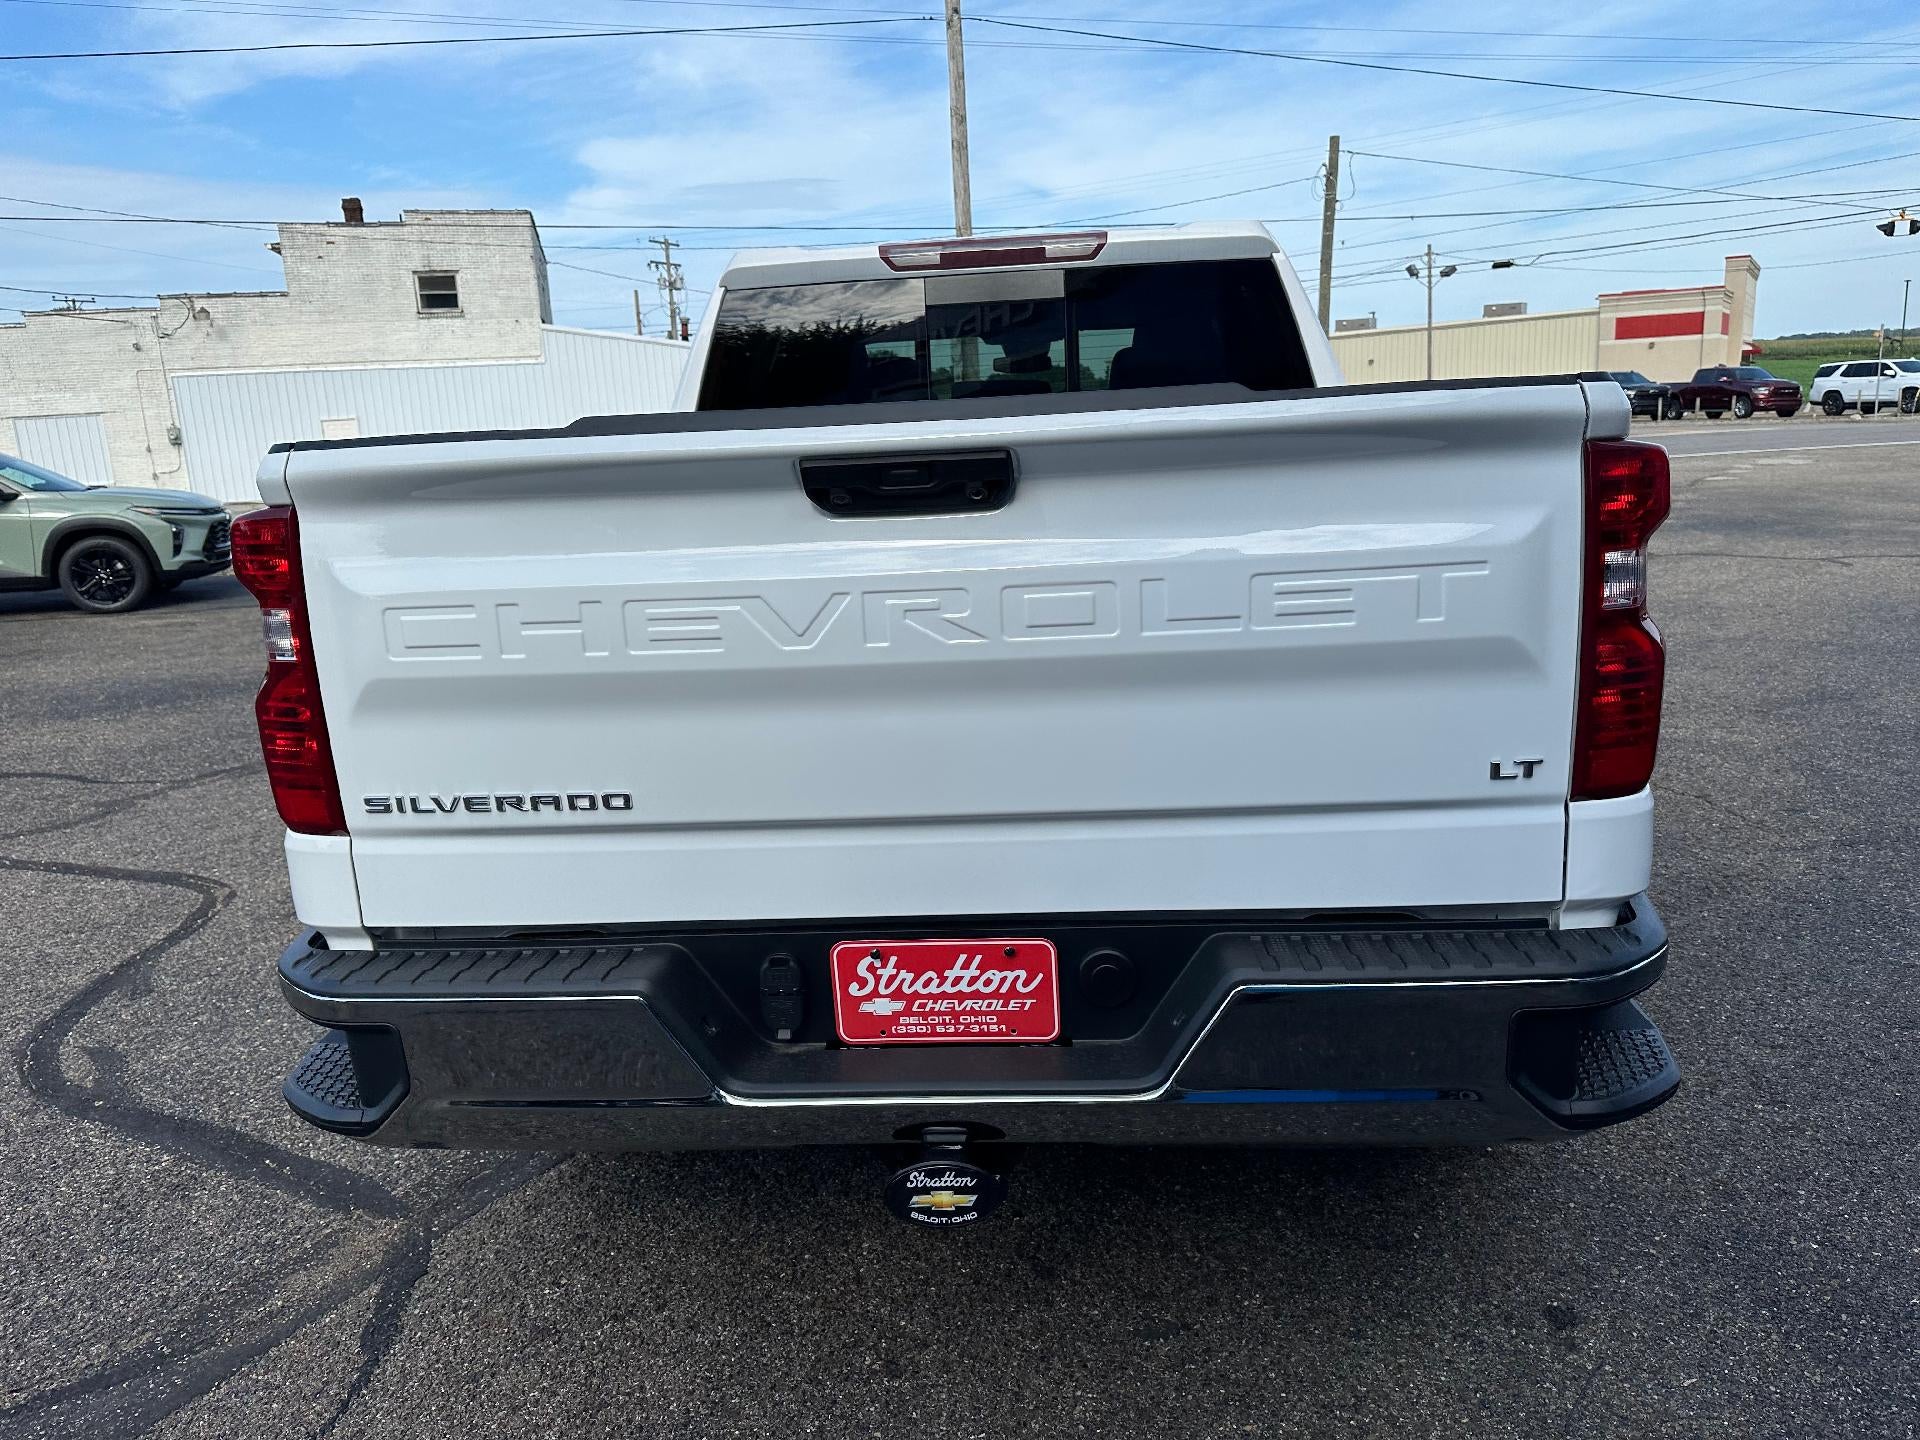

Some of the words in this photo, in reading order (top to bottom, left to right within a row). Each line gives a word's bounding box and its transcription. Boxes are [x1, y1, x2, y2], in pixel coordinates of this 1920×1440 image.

[382, 561, 1492, 662] CHEVROLET
[1489, 759, 1544, 779] LT
[363, 790, 634, 814] SILVERADO
[848, 954, 1044, 997] Stratton
[911, 999, 1037, 1012] CHEVROLET
[899, 1015, 954, 1024] BELOIT,
[959, 1015, 998, 1024] OHIO
[891, 1025, 931, 1034] (330)
[907, 1171, 978, 1188] Stratton
[952, 1211, 978, 1223] OHIO
